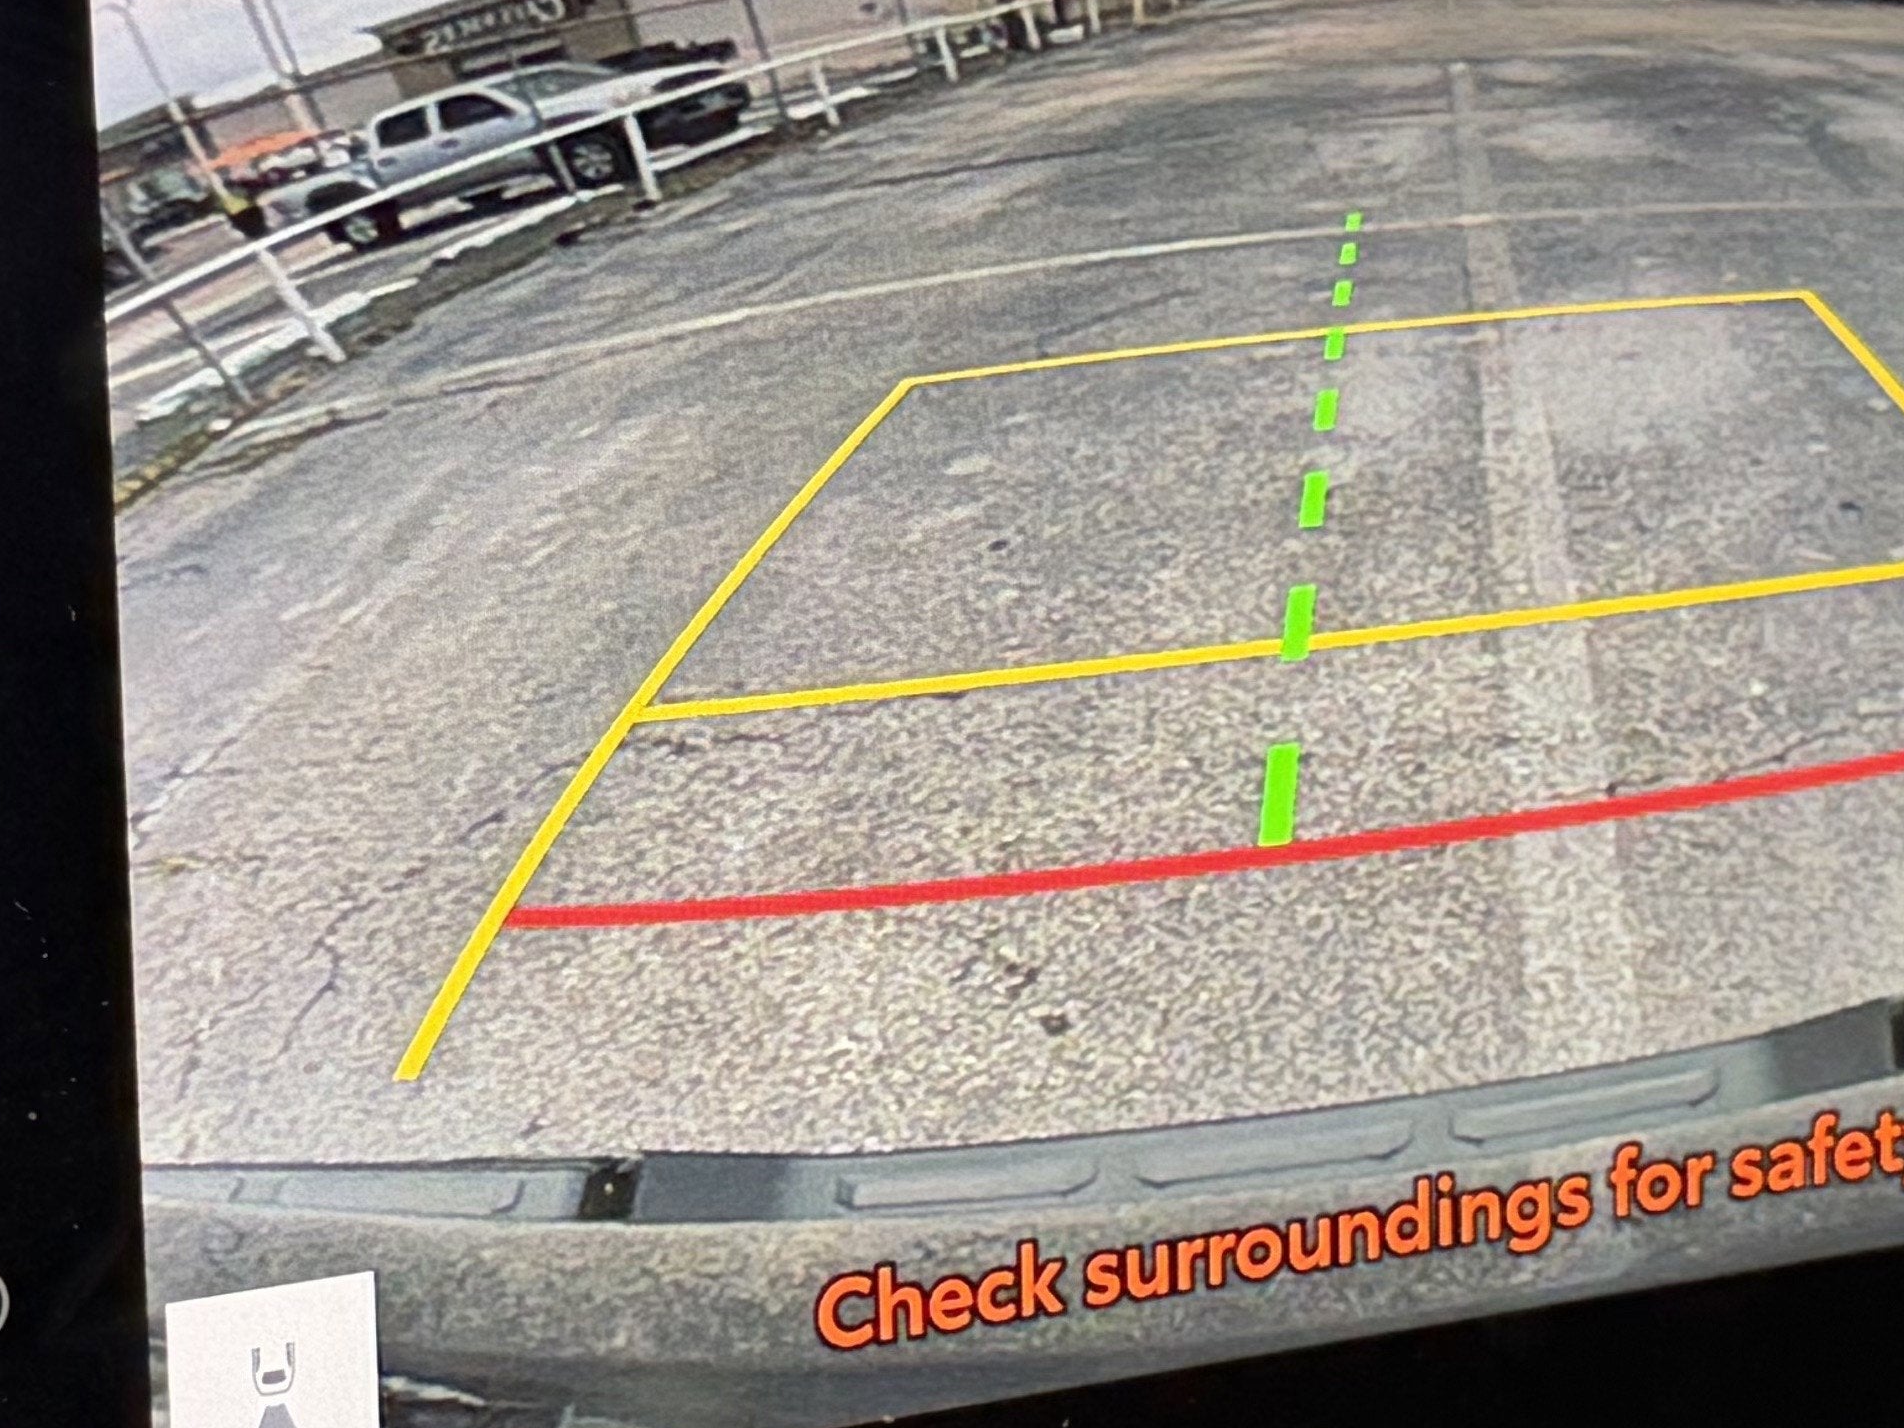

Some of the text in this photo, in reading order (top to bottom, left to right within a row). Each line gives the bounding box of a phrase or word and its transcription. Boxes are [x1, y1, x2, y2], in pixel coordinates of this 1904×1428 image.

[814, 1243, 1063, 1350] Check
[1080, 1173, 1593, 1309] surroundings
[1609, 1143, 1712, 1221] for
